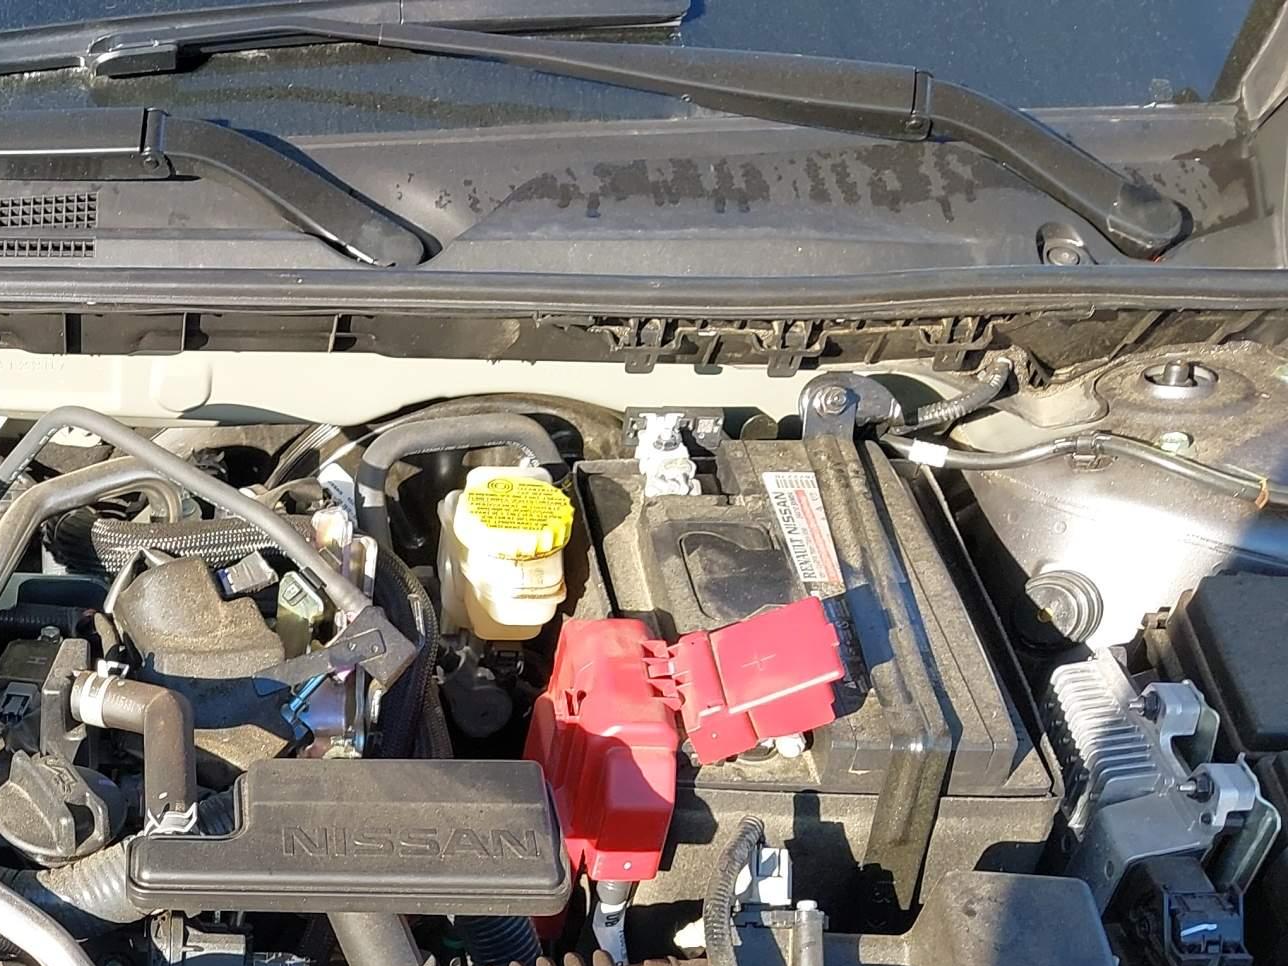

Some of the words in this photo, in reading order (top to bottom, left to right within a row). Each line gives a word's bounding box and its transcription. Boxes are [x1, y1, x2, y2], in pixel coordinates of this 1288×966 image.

[772, 491, 799, 535] NISSAN
[790, 538, 817, 579] RENAULT
[281, 824, 542, 861] NISSAN
